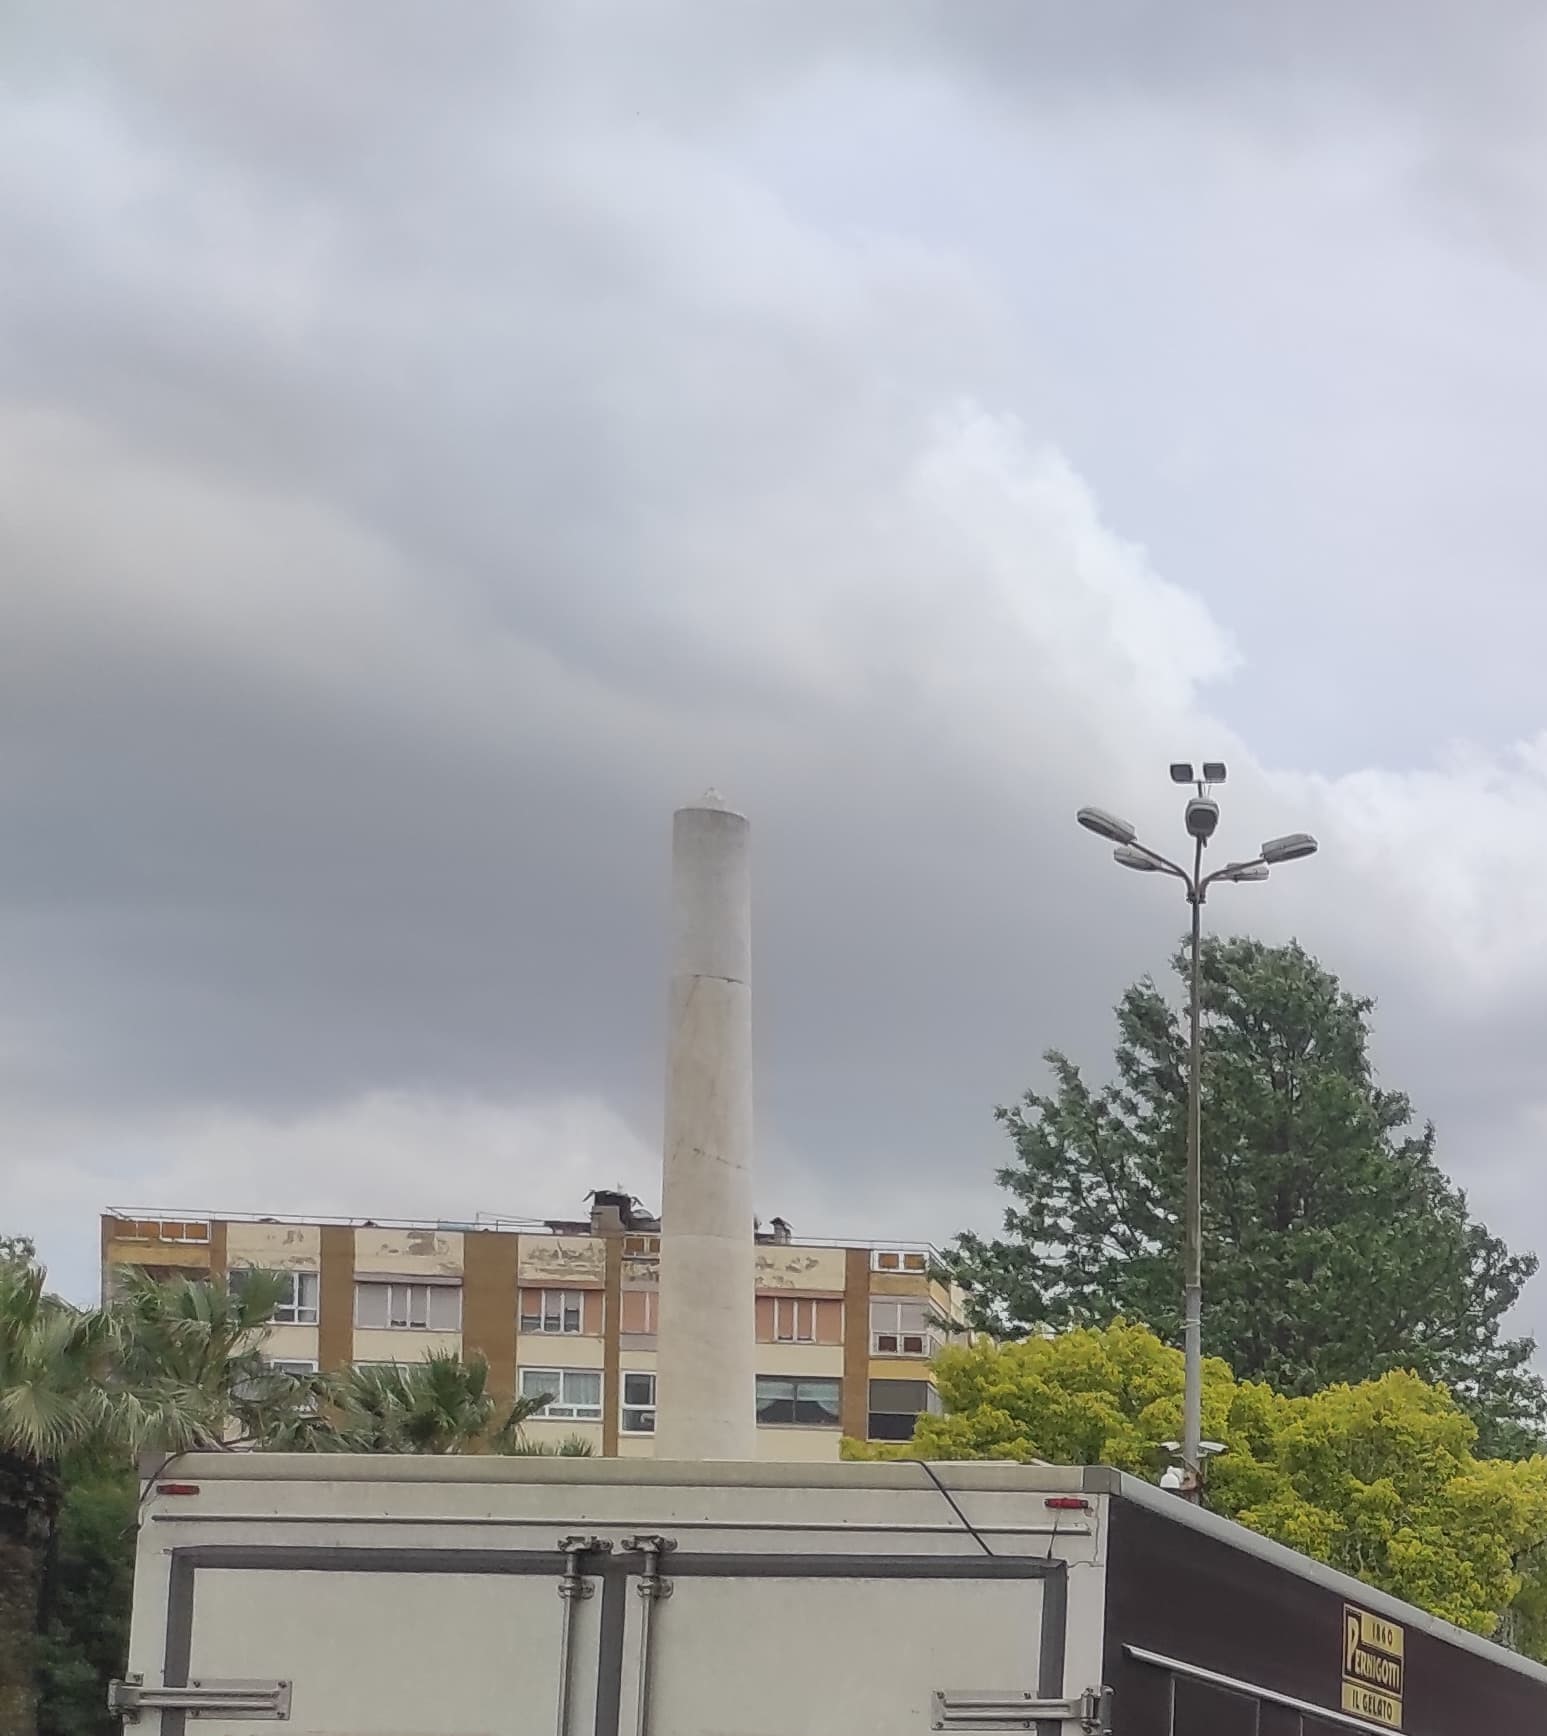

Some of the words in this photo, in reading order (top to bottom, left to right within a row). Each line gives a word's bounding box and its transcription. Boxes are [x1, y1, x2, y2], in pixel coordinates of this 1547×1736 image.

[1372, 1623, 1393, 1647] 1860
[1347, 1615, 1400, 1689] PERNIGOTTI
[1353, 1690, 1360, 1709] IL
[1363, 1694, 1393, 1720] GELATO
